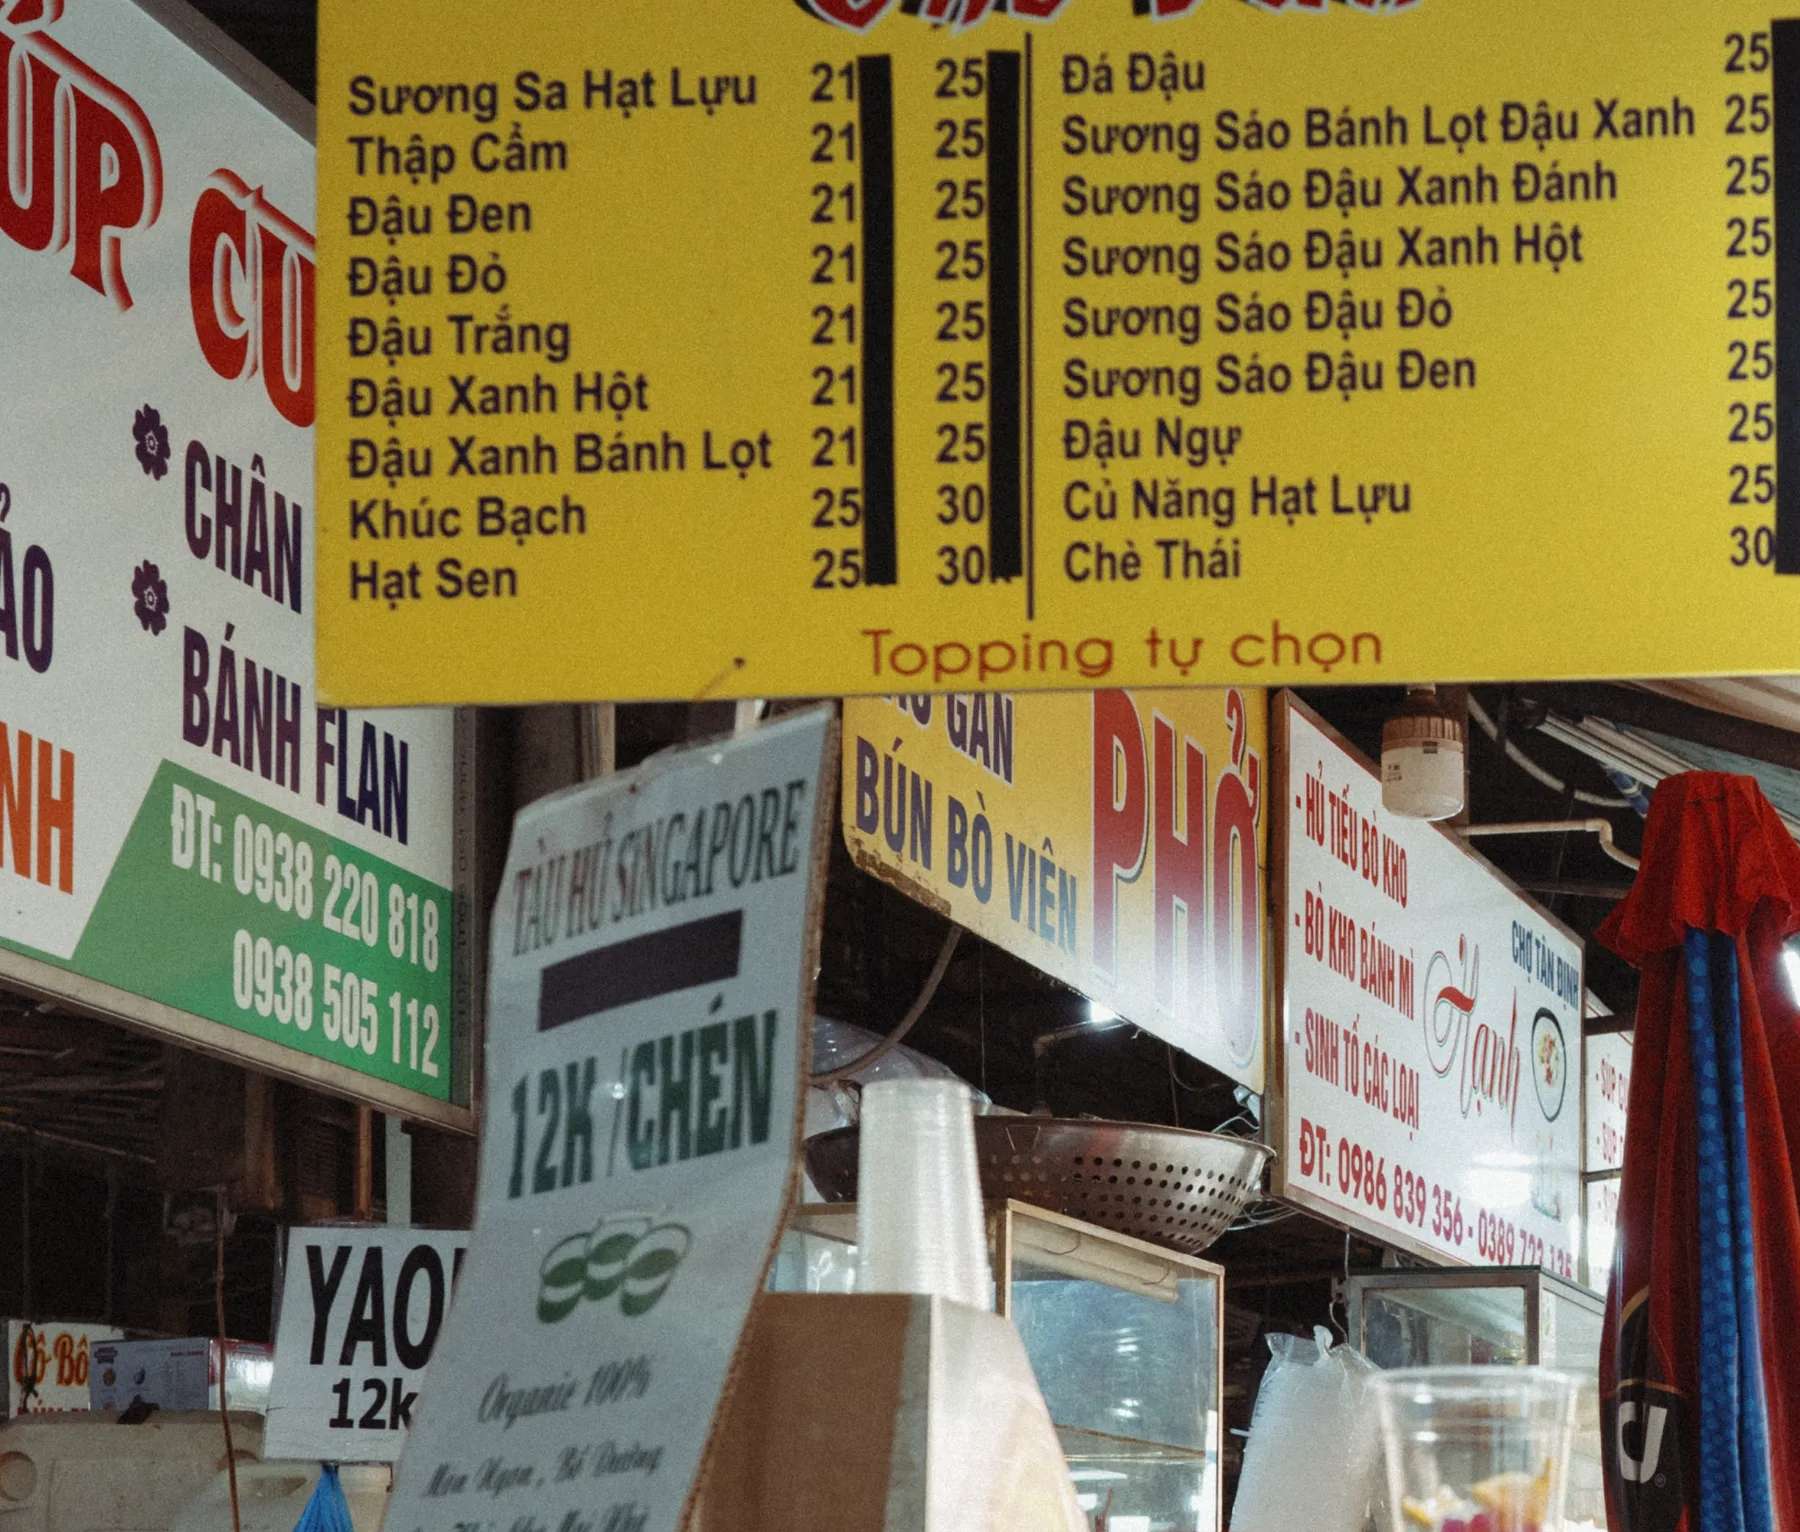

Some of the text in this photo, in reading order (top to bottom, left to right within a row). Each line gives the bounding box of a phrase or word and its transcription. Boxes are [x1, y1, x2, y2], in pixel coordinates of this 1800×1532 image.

[349, 58, 986, 123] Sương Sa Hạt Lựu 21 25
[1061, 54, 1113, 94] Đá
[1127, 51, 1204, 102] Đậu
[1725, 32, 1771, 73] 25
[348, 122, 567, 184] Thập Cẩm
[1063, 97, 1694, 163] Sương Sáo Bánh Lọt Đậu Xanh
[347, 194, 531, 245] Đậu Đen
[1063, 161, 1616, 224] Sương Sáo Đậu Xanh Đánh
[347, 252, 506, 306] Đậu Đỏ
[1063, 222, 1582, 285] Sương Sáo Đậu Xanh Hột
[347, 305, 570, 366] Đậu Trắng
[1064, 287, 1452, 346] Sương Sáo Đậu Đỏ
[347, 371, 648, 427] Đậu Xanh Hột
[1064, 349, 1475, 407] Sương Sáo Đậu Đen
[347, 431, 772, 488] Đậu Xanh Bánh Lọt
[1063, 417, 1242, 469] Đậu Ngự
[185, 440, 301, 614] CHÂN
[350, 484, 988, 546] Khúc Bạch 25 30
[1064, 475, 1410, 528] Củ Năng Hạt Lựu
[350, 558, 517, 610] Hạt Sen
[1064, 541, 1141, 582] Chè
[1155, 538, 1240, 579] Thái
[1731, 526, 1774, 567] 30
[862, 620, 1381, 684] Topping tự chọn
[183, 622, 408, 845] BÁNH FLAN
[611, 778, 806, 923] SINGAPORE
[856, 736, 1077, 954] BÚN BÒ VIÊN
[1306, 760, 1408, 908] HỦ TIẾU BÒ KHO
[171, 783, 439, 973] ĐT: 0938 220 818
[1093, 688, 1261, 1068] PHỞ
[1305, 881, 1414, 1021] BÒ KHO BÁNH MÌ
[233, 930, 439, 1077] 0938 505 112
[1305, 1007, 1419, 1141] SINH TỐ CÁC LOẠI
[508, 1052, 598, 1200] 12K
[1299, 1117, 1331, 1186] ĐT:
[1338, 1137, 1386, 1211] 0986
[1393, 1164, 1426, 1228] 839
[1432, 1184, 1463, 1246] 356
[1478, 1208, 1515, 1265] 0389
[306, 1244, 468, 1370] YAO
